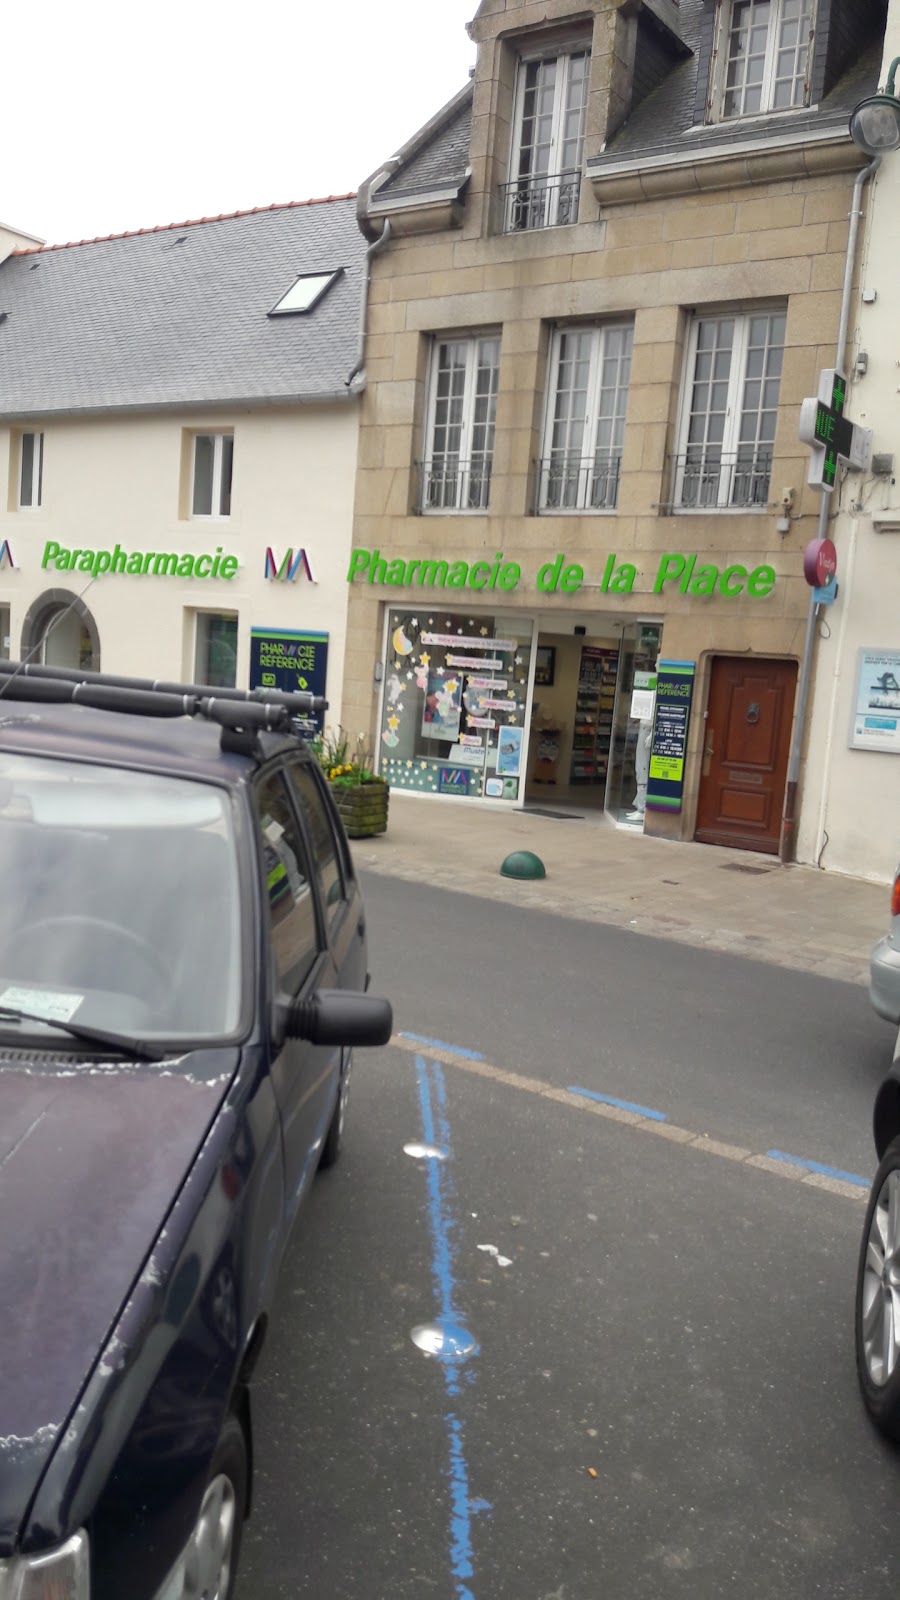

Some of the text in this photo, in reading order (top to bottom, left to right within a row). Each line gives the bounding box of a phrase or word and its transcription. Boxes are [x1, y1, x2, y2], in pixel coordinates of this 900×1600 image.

[42, 541, 239, 580] Parapharmacie
[347, 550, 776, 598] Pharmacie de la Place
